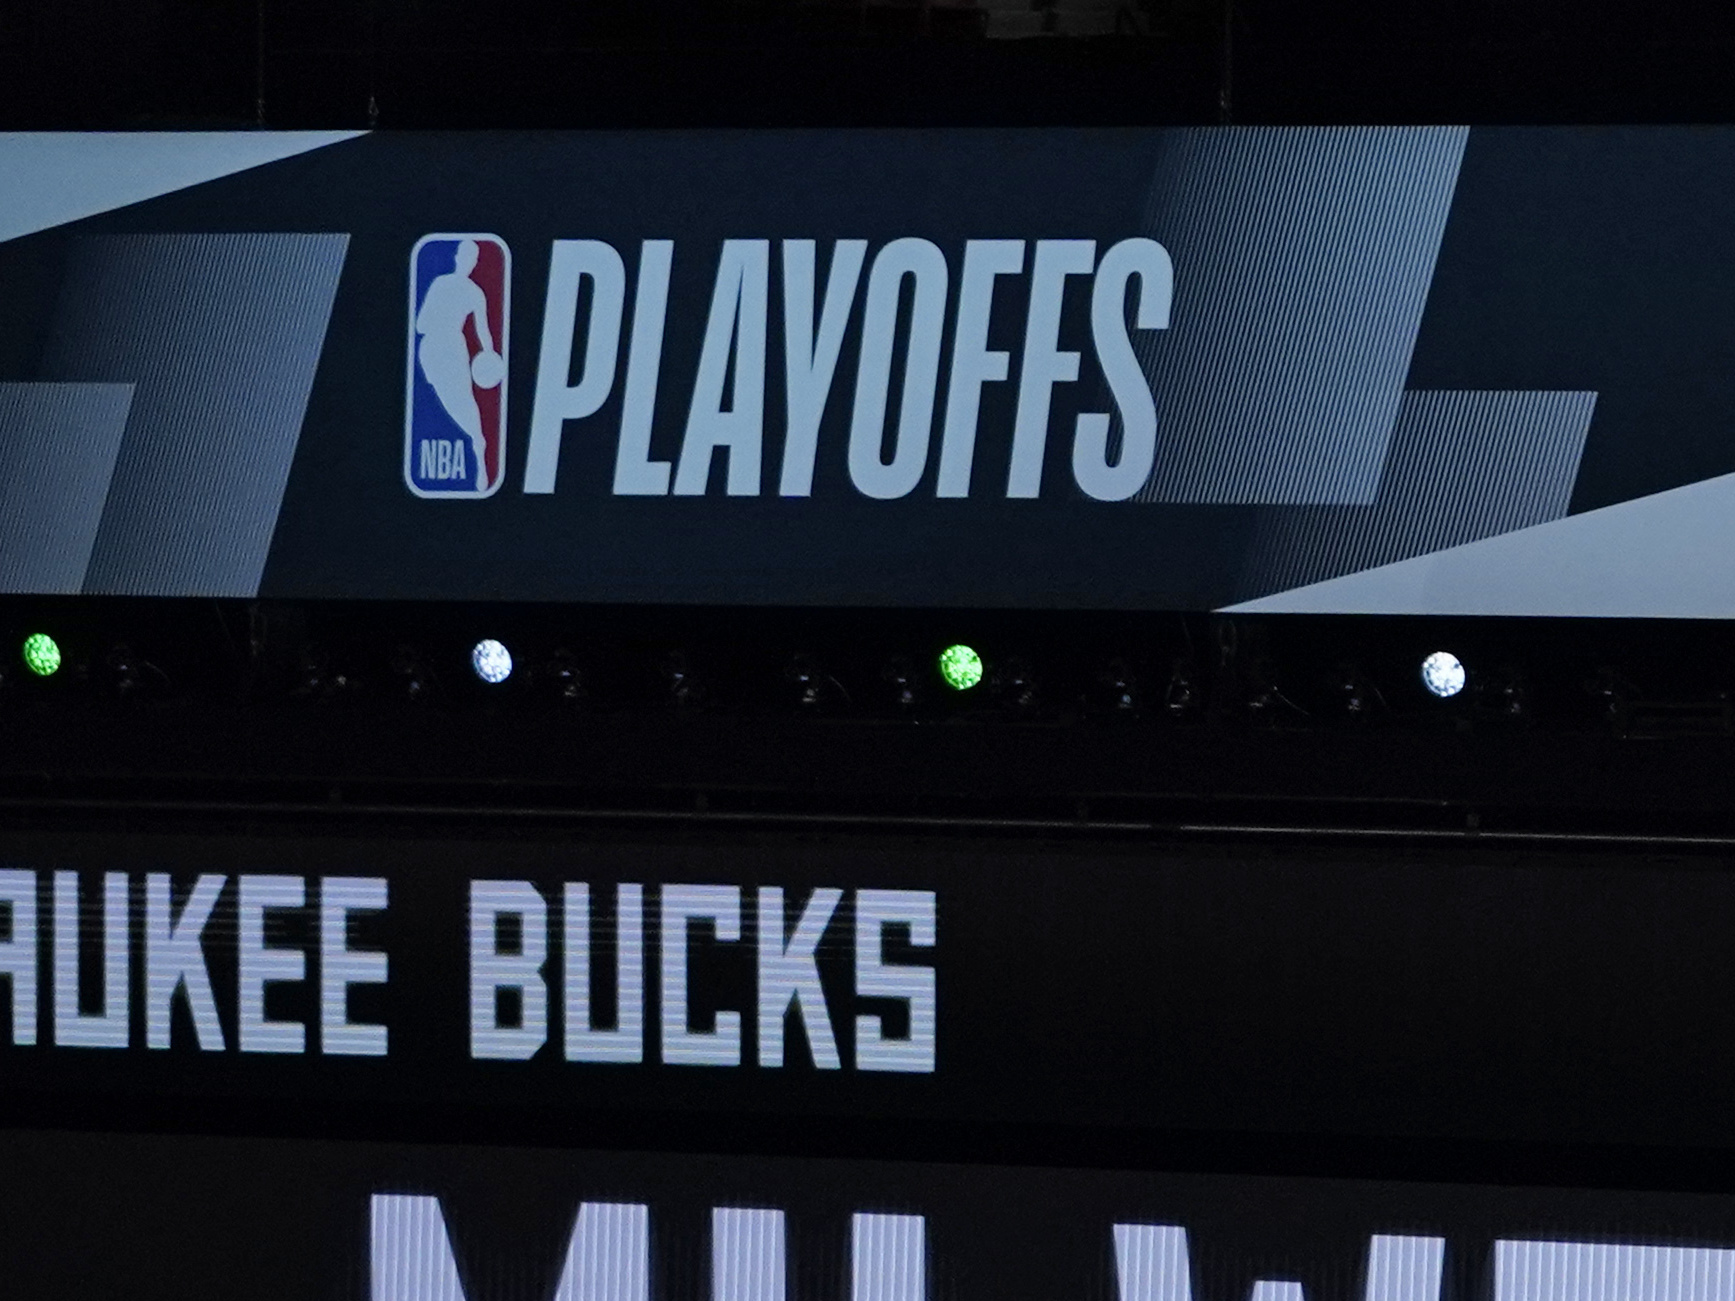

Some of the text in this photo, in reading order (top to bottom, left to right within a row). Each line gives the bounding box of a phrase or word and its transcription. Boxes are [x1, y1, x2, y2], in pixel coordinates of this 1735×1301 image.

[418, 237, 1175, 501] NBA PLAYOFFS
[469, 880, 937, 1072] BUCKS
